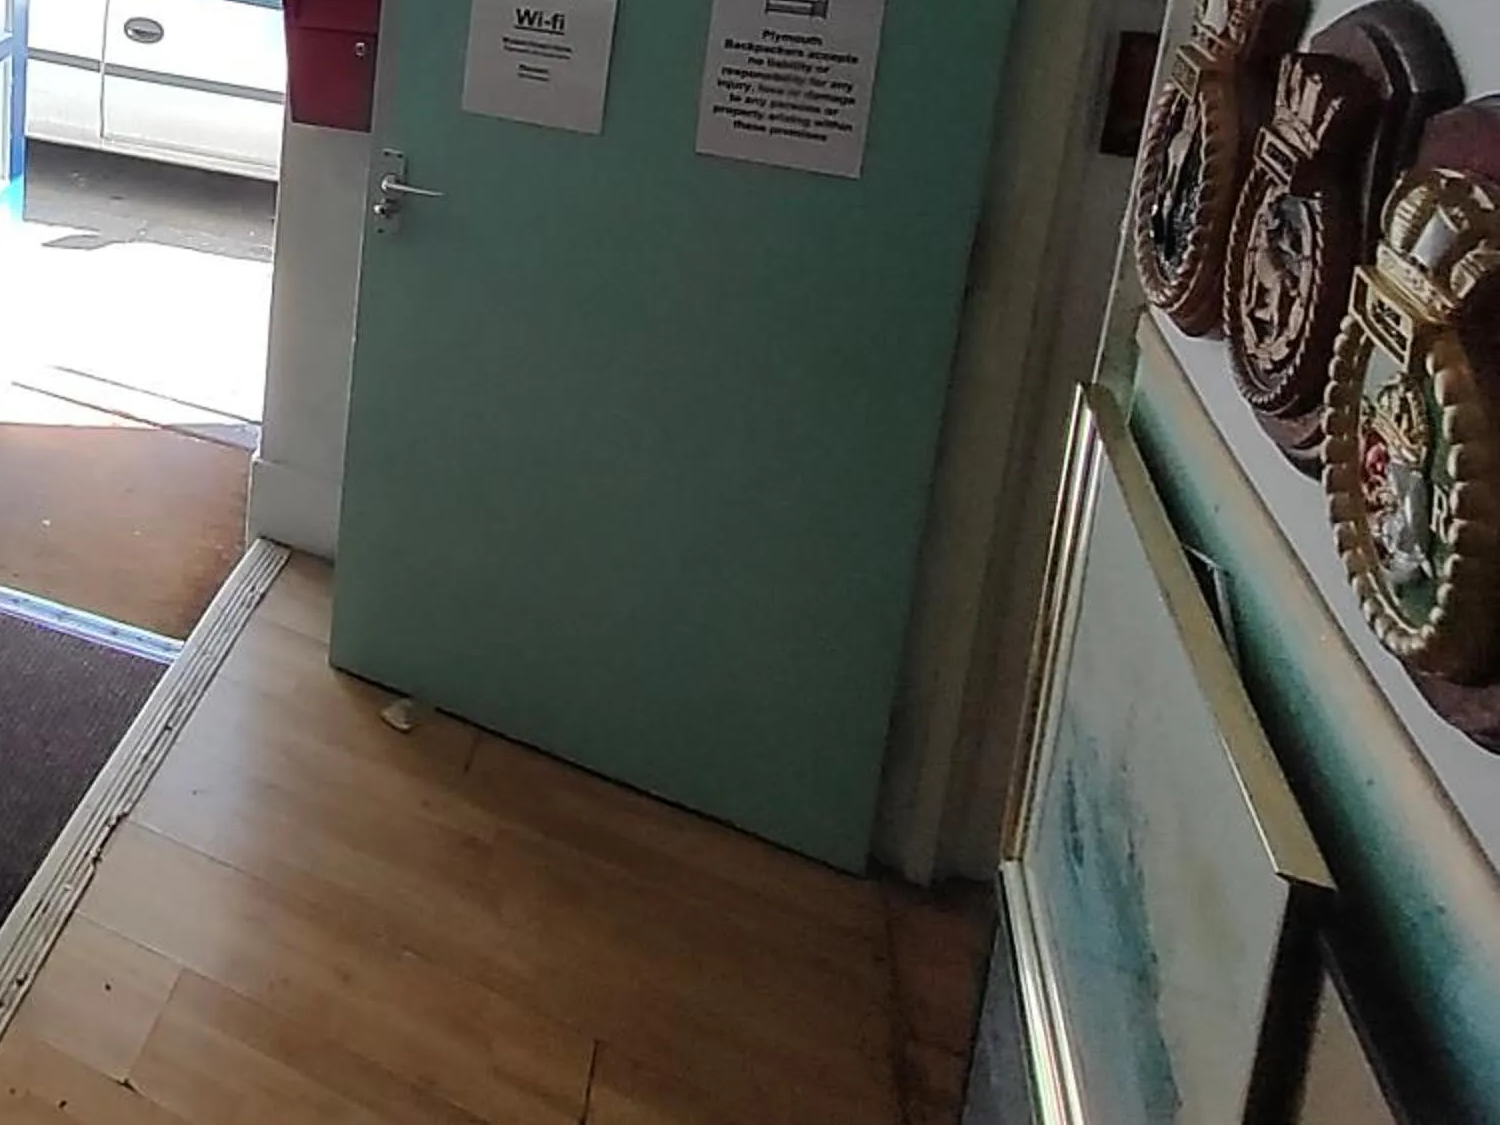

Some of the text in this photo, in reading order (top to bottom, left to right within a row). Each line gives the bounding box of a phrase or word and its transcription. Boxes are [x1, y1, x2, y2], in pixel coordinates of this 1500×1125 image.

[516, 7, 566, 32] Wi-fi
[723, 37, 805, 58] Backpackers
[761, 29, 823, 46] Plymouth
